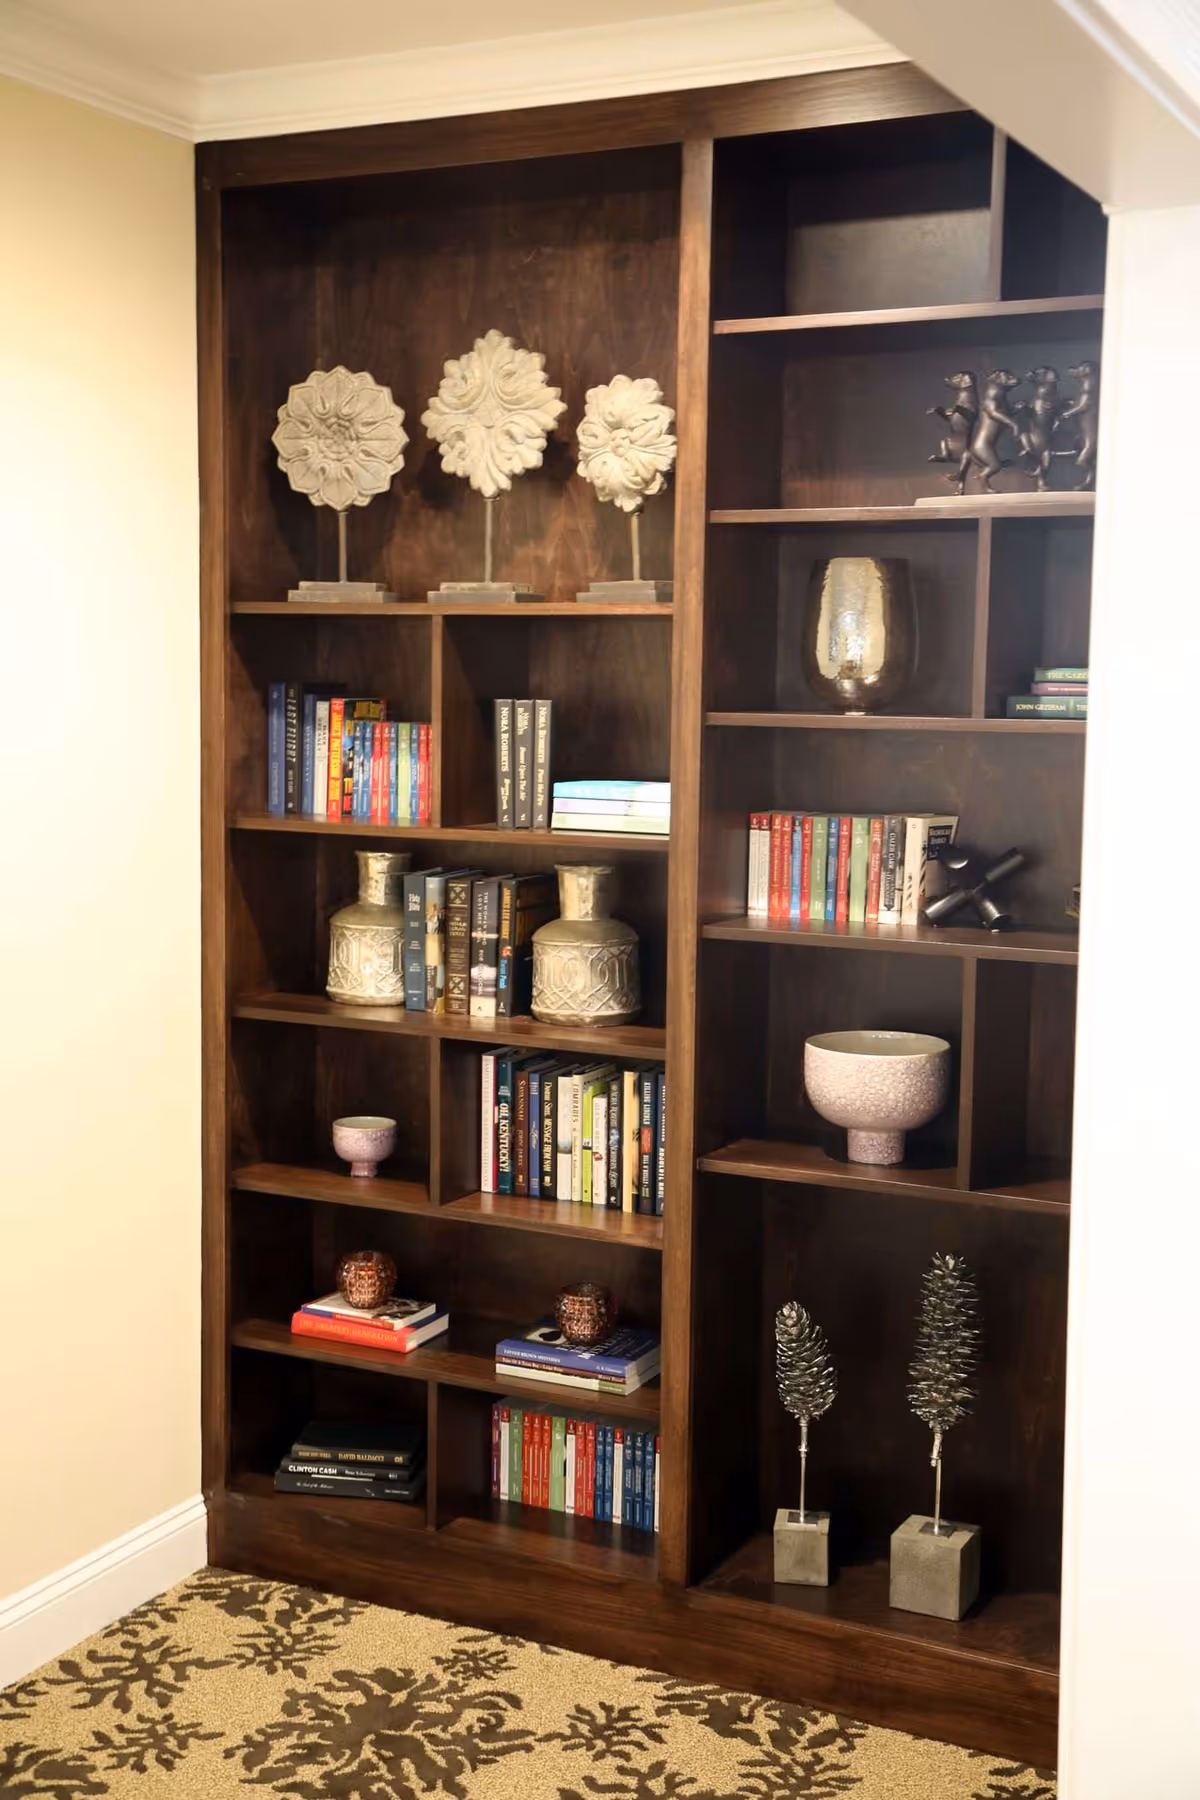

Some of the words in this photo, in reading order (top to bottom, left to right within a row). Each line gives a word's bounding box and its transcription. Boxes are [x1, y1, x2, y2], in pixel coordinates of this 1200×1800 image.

[286, 699, 297, 725] LAST
[538, 707, 548, 728] NORA
[1015, 703, 1034, 712] JOHN
[500, 706, 509, 731] NORA
[286, 727, 298, 763] FLIGHT
[500, 732, 509, 772] ROBERTS
[538, 729, 547, 763] ROBERTS
[888, 852, 897, 869] CARR
[501, 887, 512, 908] JAMES
[501, 909, 511, 920] LEE
[518, 1080, 527, 1121] SAVANNAH
[609, 1091, 619, 1106] NORA
[643, 1081, 652, 1102] KILLING
[499, 1102, 510, 1118] OH,
[571, 1083, 579, 1123] COMRADES
[609, 1107, 619, 1127] ROBERTS
[643, 1103, 652, 1125] LINCOLN
[544, 1118, 553, 1143] MESSAGE
[498, 1119, 511, 1173] KENTUCKY!
[543, 1144, 552, 1160] FROM
[543, 1161, 552, 1172] NAM
[609, 1170, 619, 1188] LIGHTS
[314, 1321, 350, 1337] GREATEST
[351, 1327, 399, 1344] GENERATION
[521, 1351, 537, 1360] BROWN
[338, 1452, 356, 1461] DAVID
[357, 1454, 384, 1463] BALDACCI
[288, 1464, 318, 1474] CLINTON
[318, 1466, 337, 1475] CASH
